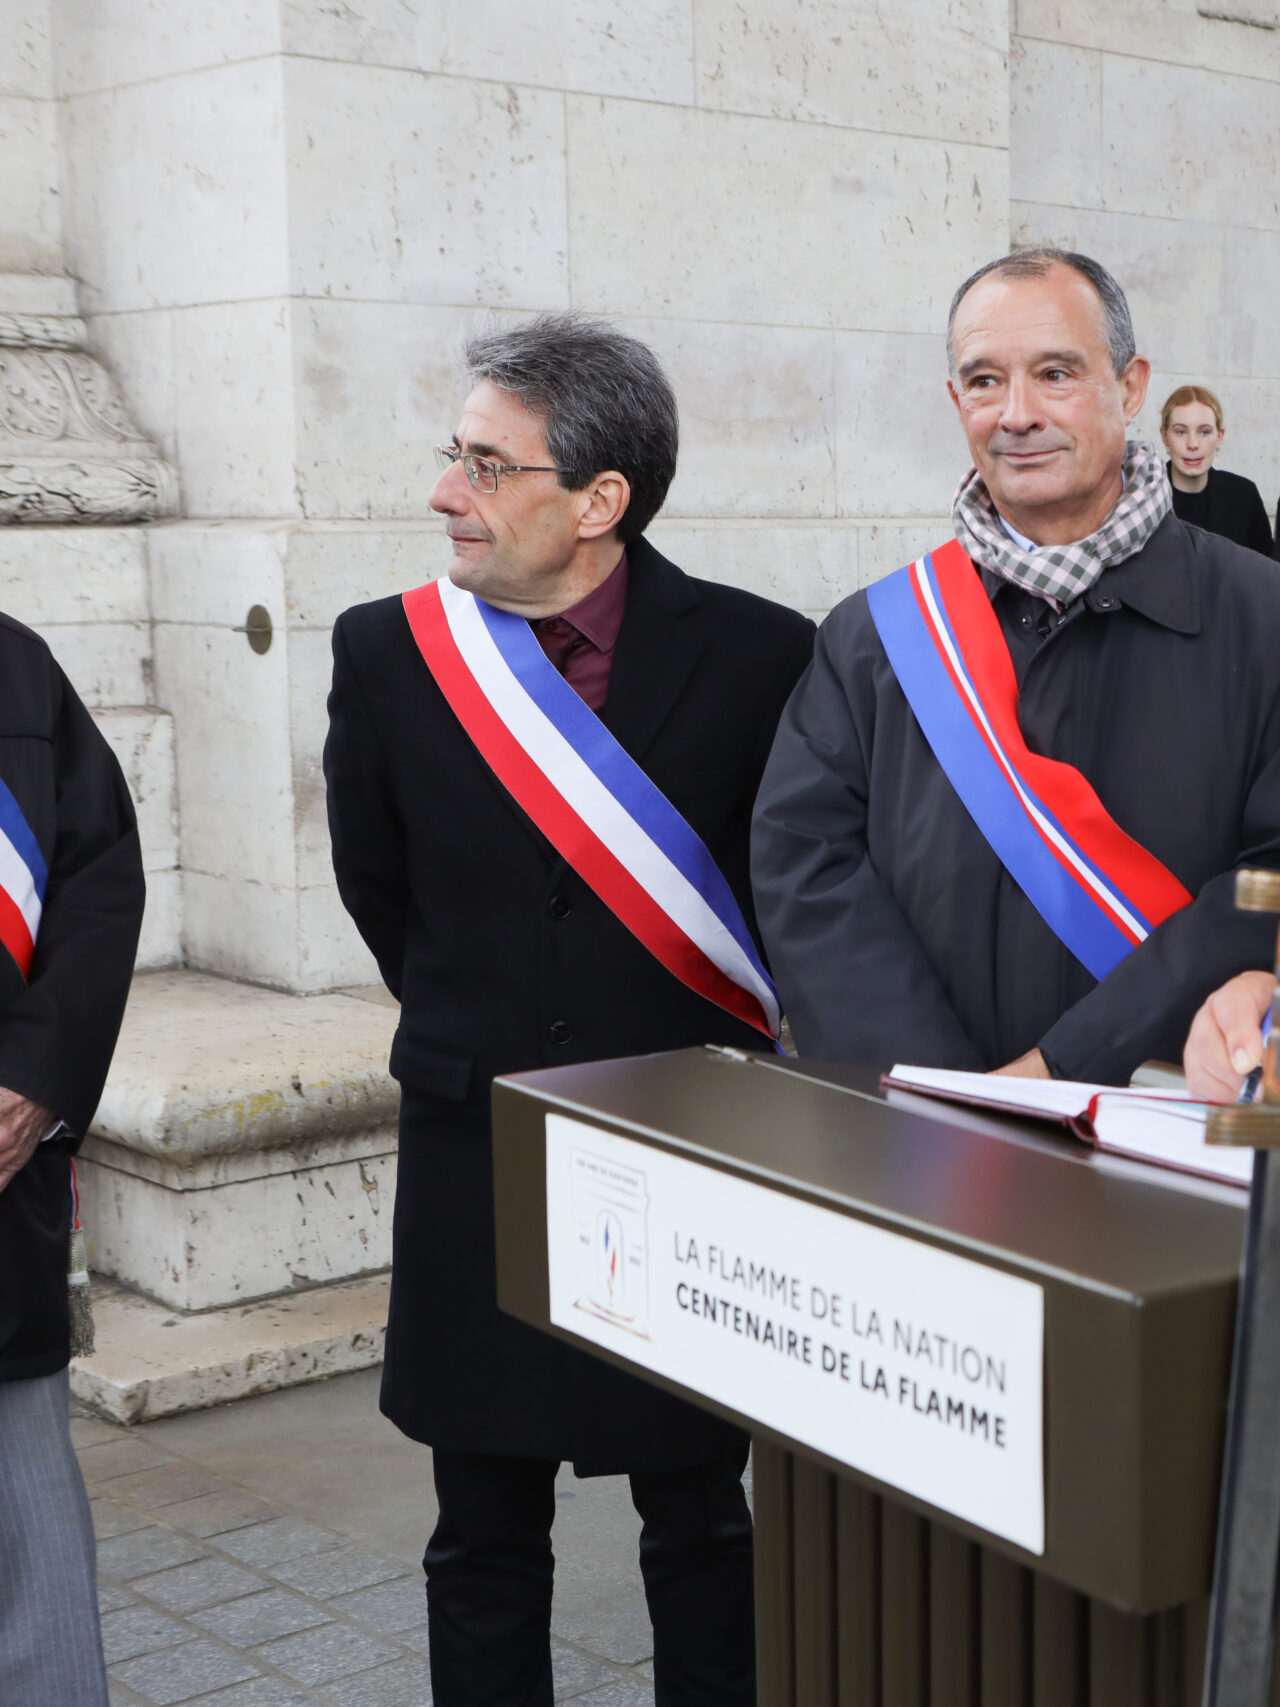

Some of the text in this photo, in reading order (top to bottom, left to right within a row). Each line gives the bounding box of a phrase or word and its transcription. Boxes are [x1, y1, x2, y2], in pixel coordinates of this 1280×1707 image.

[674, 1231, 1006, 1393] LA FLAMME DE LA NATION
[676, 1282, 1005, 1448] CENTENAIRE DE LA FLAMME
